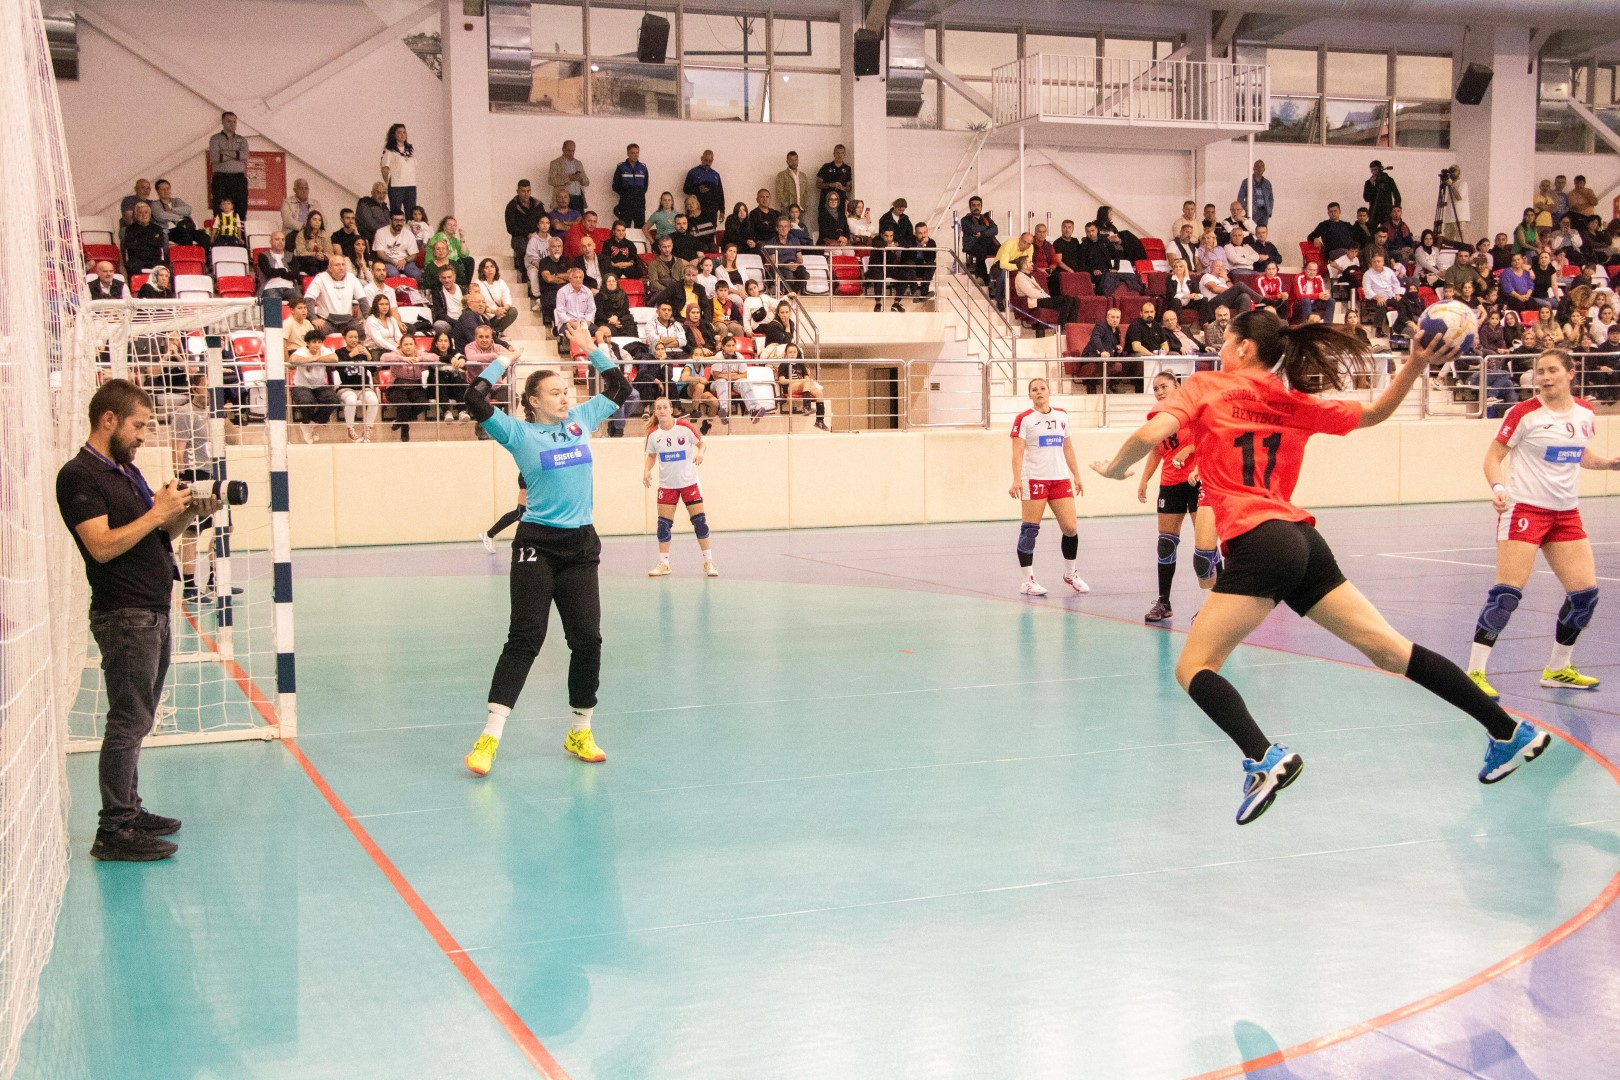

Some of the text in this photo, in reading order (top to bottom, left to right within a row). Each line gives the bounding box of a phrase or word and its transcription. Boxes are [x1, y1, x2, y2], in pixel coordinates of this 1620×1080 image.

[1231, 406, 1284, 426] HENTBOL
[1046, 420, 1057, 429] 27
[1565, 423, 1575, 438] 9
[666, 438, 672, 447] 8
[1162, 433, 1179, 450] 18
[553, 452, 575, 462] ERSTE
[1233, 431, 1283, 490] 11
[658, 490, 664, 499] 8
[1033, 484, 1045, 494] 27
[1158, 499, 1165, 508] 18
[1517, 517, 1529, 532] 9
[517, 546, 538, 563] 12
